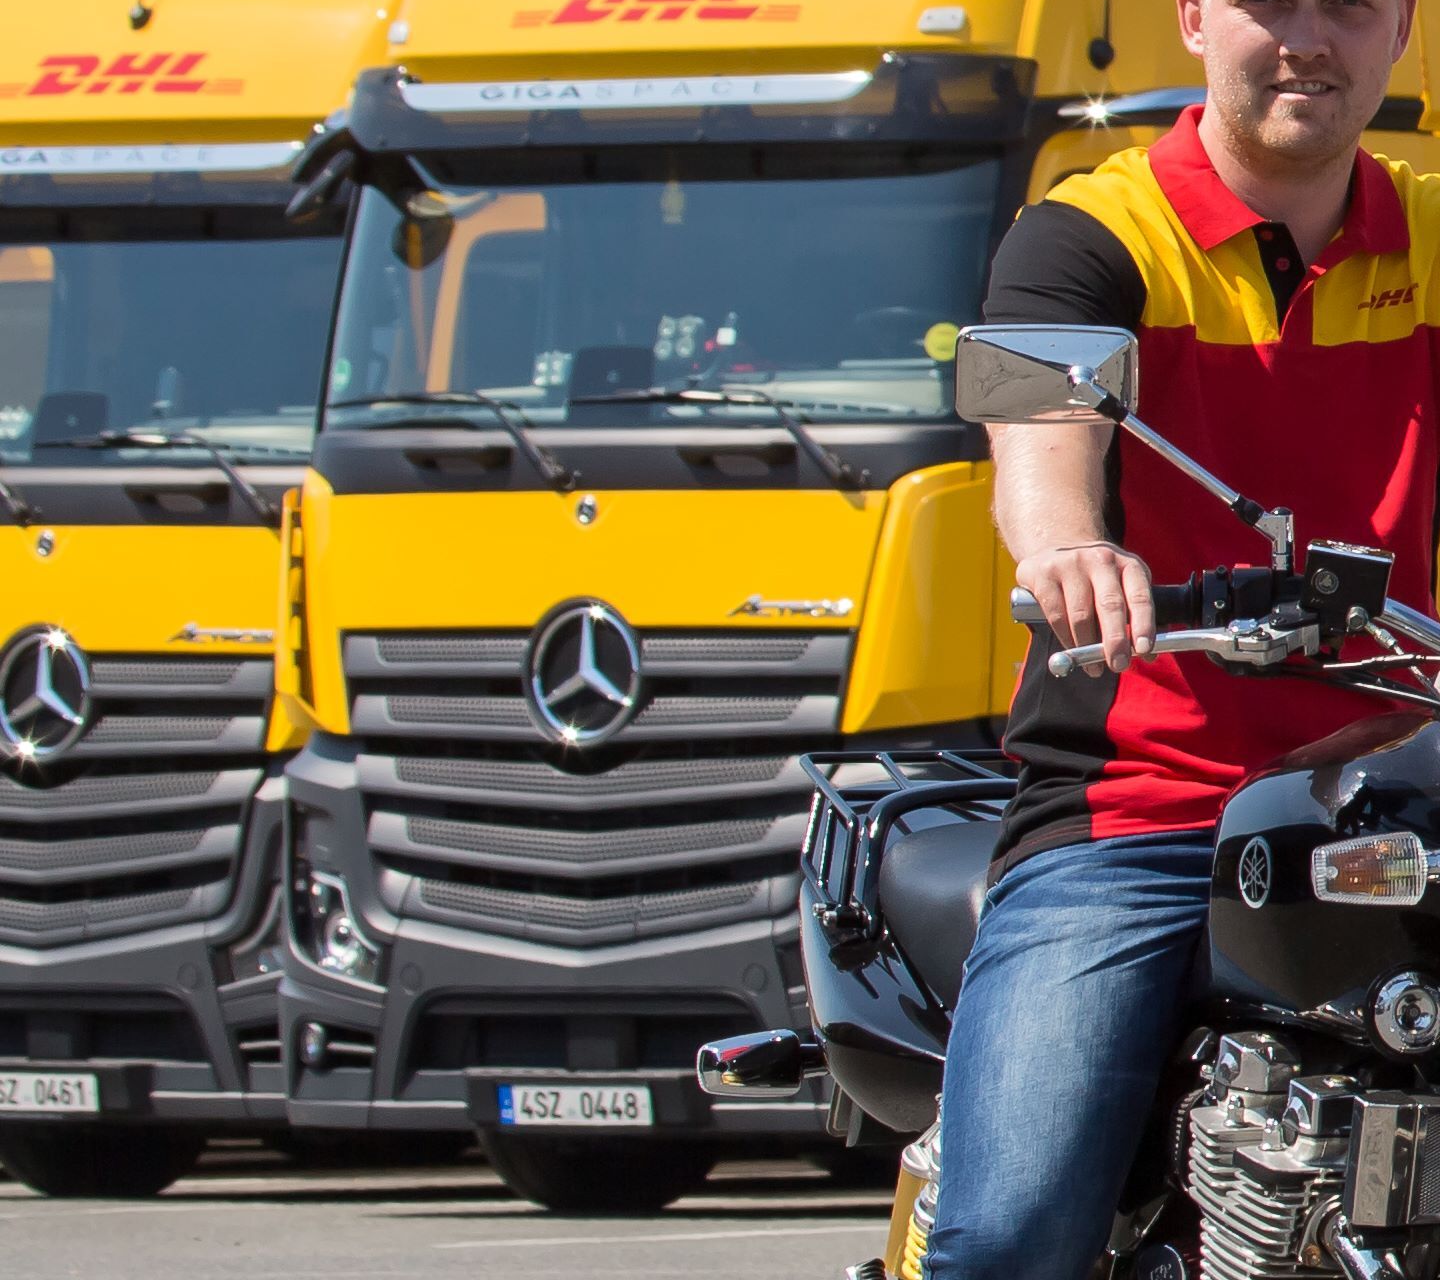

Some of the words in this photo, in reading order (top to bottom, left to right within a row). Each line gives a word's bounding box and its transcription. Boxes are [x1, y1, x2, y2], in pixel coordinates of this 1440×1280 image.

[27, 53, 207, 95] DHL
[520, 1092, 562, 1118] 4SZ
[580, 1092, 638, 1119] 0448
